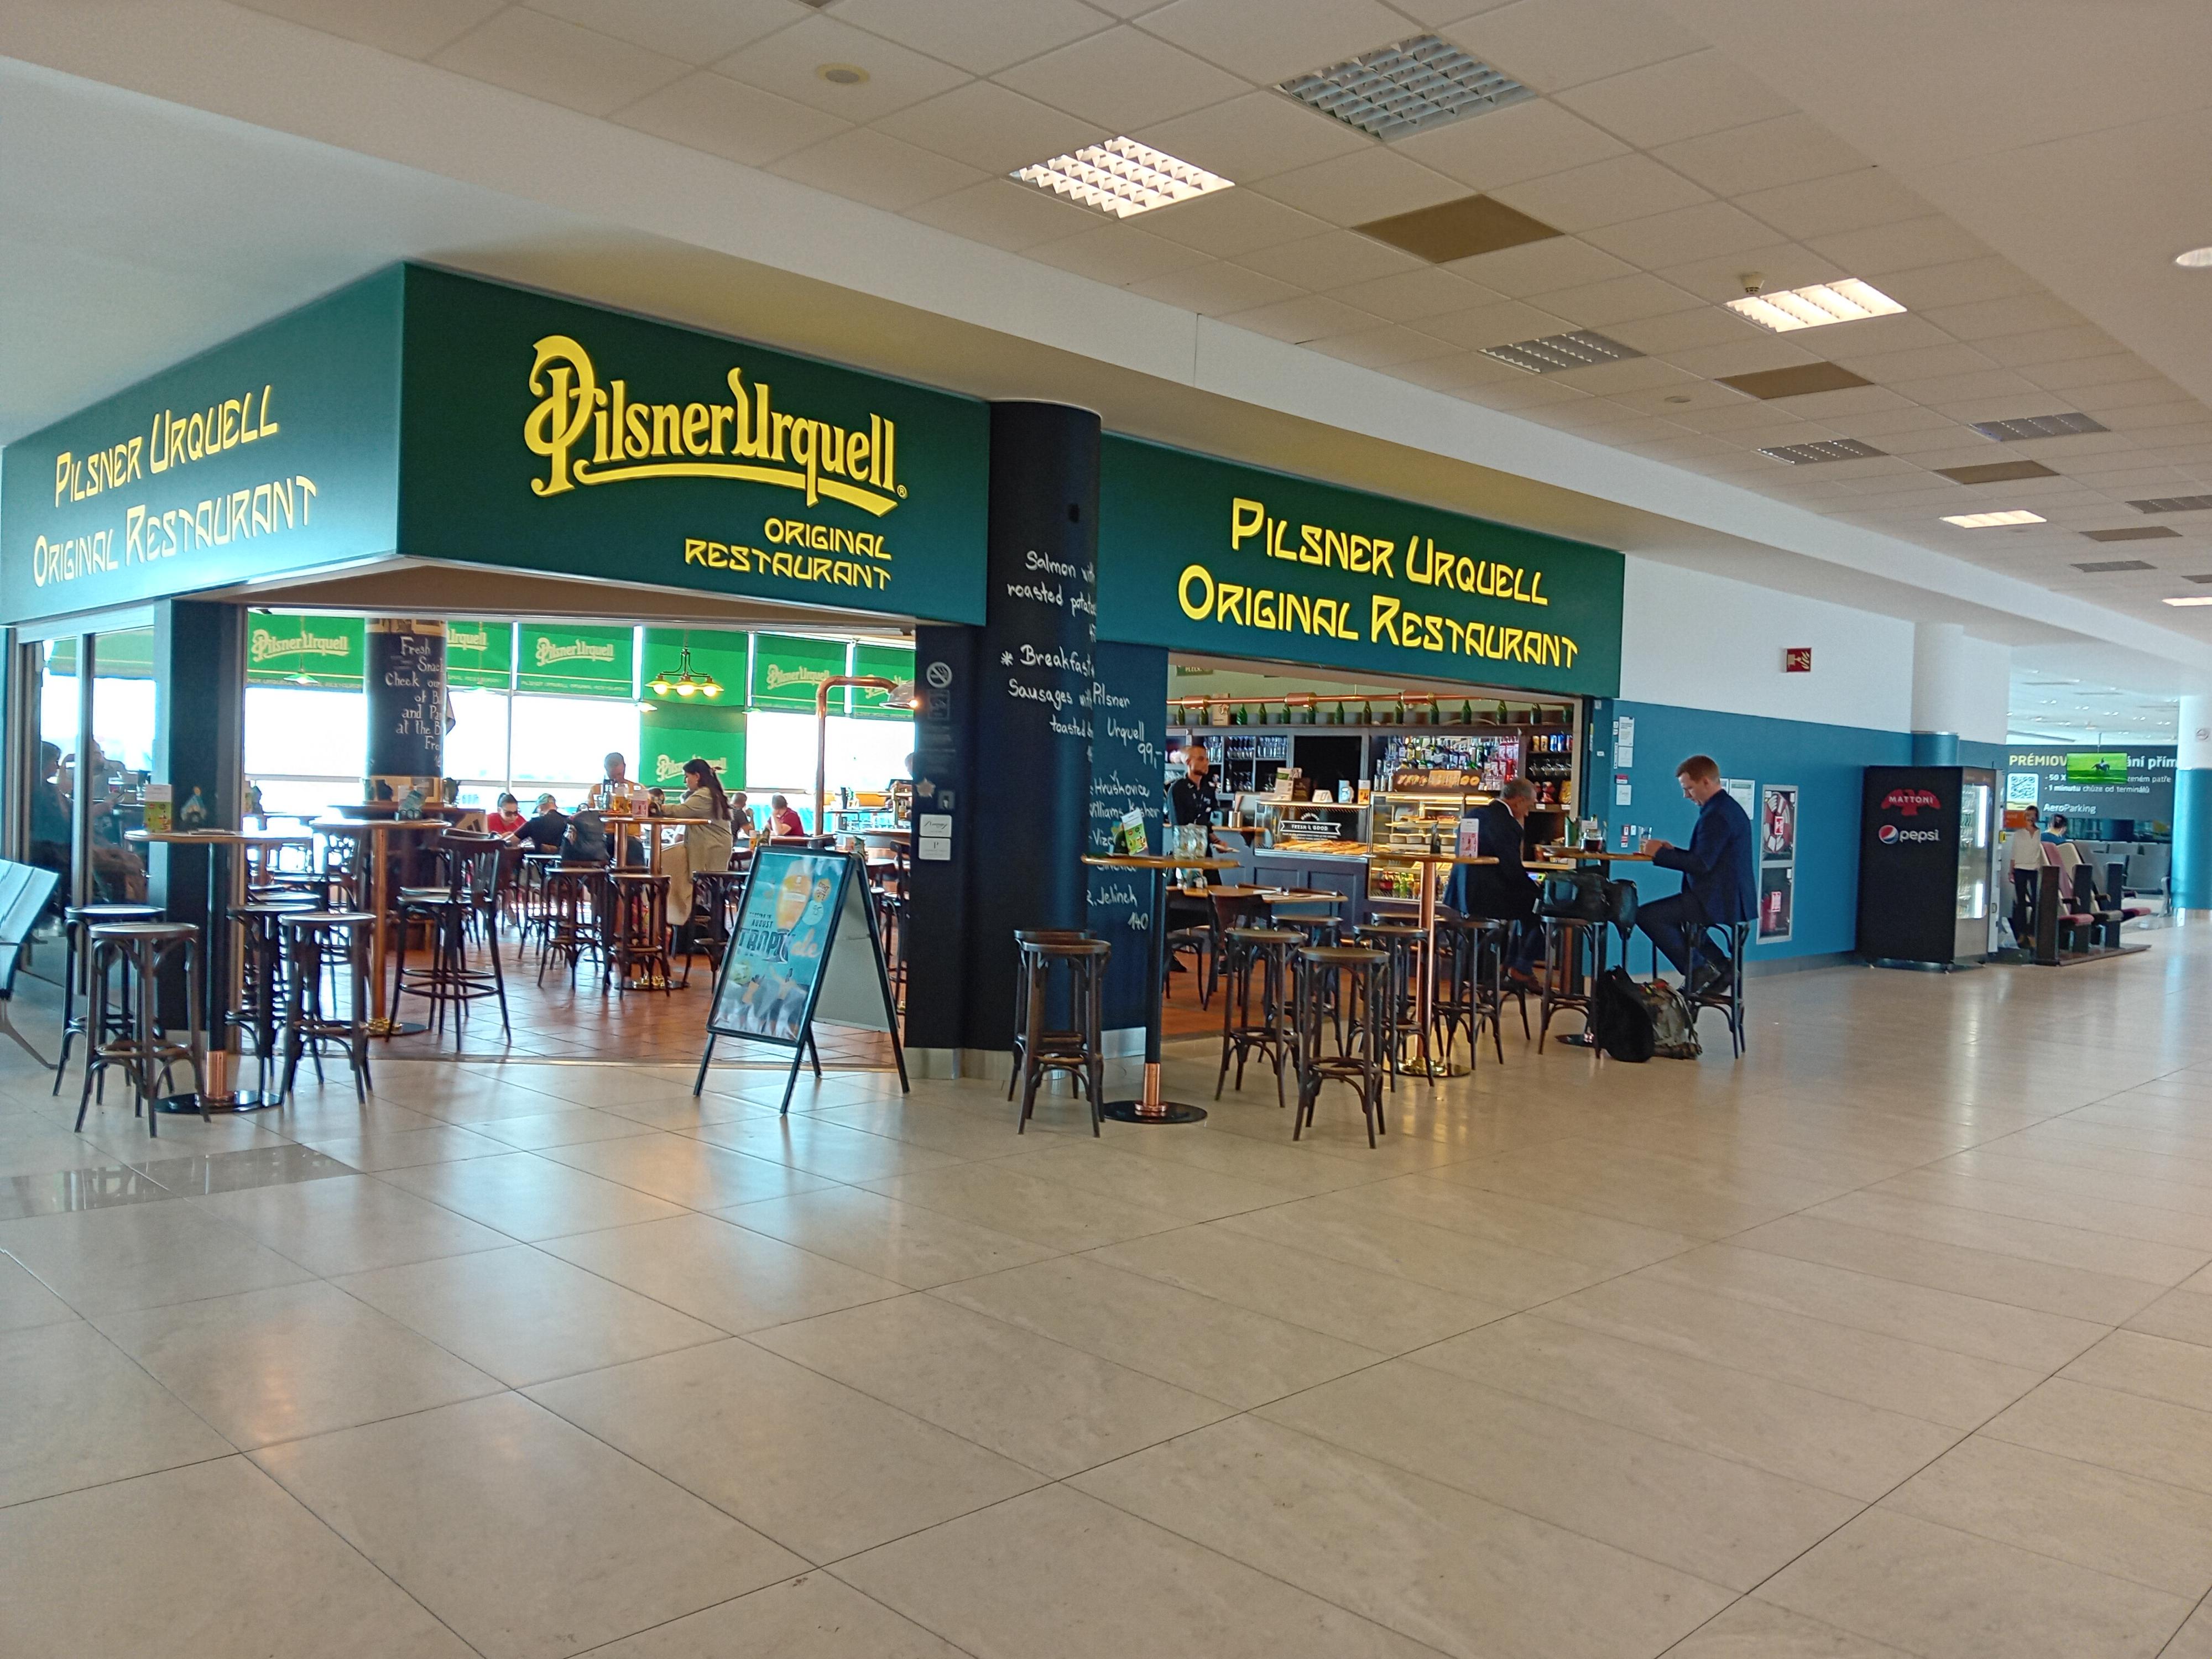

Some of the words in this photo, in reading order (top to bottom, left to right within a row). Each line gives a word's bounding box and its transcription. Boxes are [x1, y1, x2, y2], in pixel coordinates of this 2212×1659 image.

[524, 335, 736, 498] Pilsner
[727, 367, 898, 508] Urquell
[55, 436, 143, 508] PILSNER
[150, 385, 278, 474] URQUELL
[33, 529, 118, 588] ORIGINAL
[125, 475, 316, 566] RESTAURANT
[764, 517, 892, 560] ORIGINAL
[685, 538, 892, 591] RESTAURANT
[1025, 550, 1077, 579] Salmon
[1231, 497, 1395, 579] PILSNER
[1406, 535, 1549, 606] URQUELL
[1007, 581, 1064, 607] roasted
[1177, 564, 1359, 641] ORIGINAL
[1371, 594, 1579, 669] RESTAURANT
[400, 636, 431, 656] Fresh
[385, 671, 420, 687] Check
[1008, 678, 1073, 711] Sausages
[1093, 681, 1130, 708] Pilsner
[401, 705, 421, 719] and
[396, 720, 409, 734] at
[415, 720, 431, 734] the
[1107, 716, 1144, 747] Urquell
[2009, 753, 2067, 766] PRÉMIOV
[2148, 755, 2178, 770] přím
[1889, 796, 1934, 805] MATTONI
[2043, 804, 2096, 815] AeroParking
[1900, 829, 1939, 844] pepsi
[751, 919, 774, 928] AUGUST
